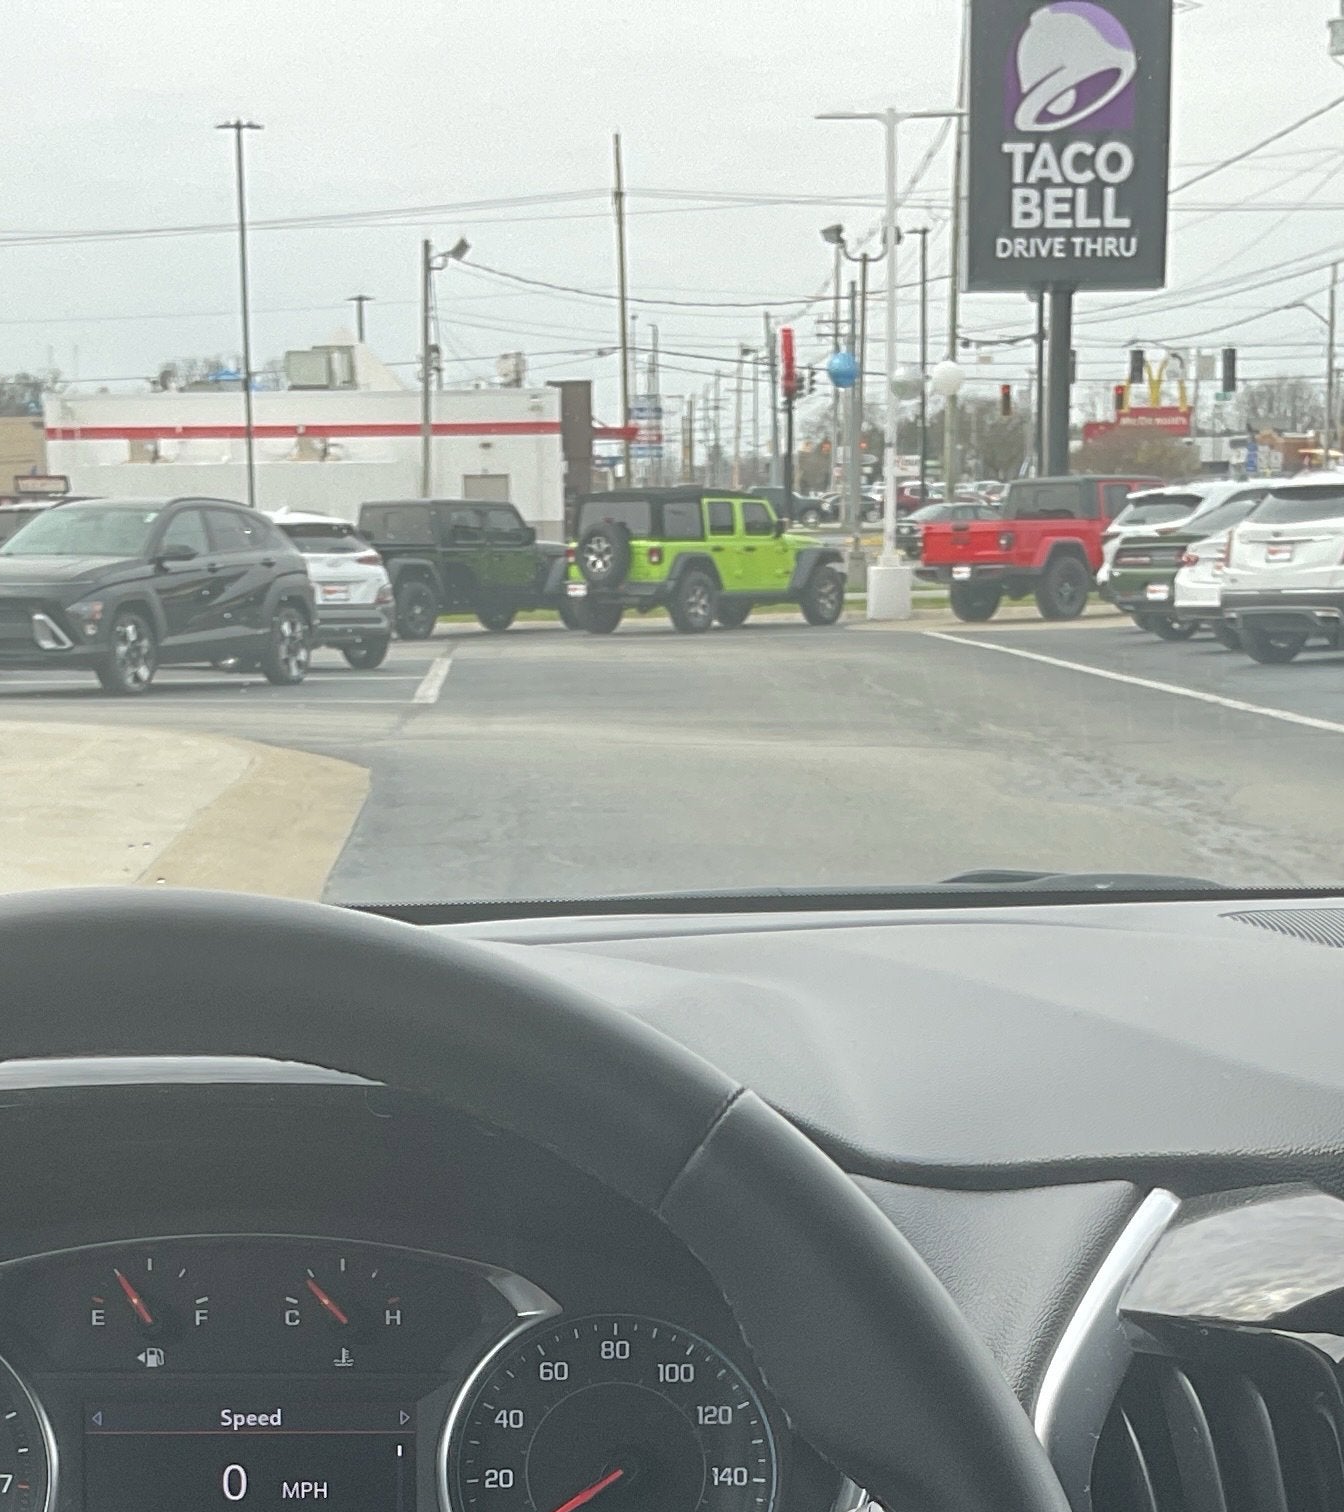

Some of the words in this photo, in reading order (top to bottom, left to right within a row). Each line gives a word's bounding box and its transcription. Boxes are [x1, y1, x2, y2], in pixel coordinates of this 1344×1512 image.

[1001, 141, 1134, 184] TACO
[1011, 187, 1131, 228] BELL
[995, 237, 1066, 258] DRIVE
[1070, 237, 1137, 258] THRU
[91, 1310, 105, 1326] E
[195, 1310, 209, 1326] F
[285, 1310, 300, 1326] C
[385, 1310, 402, 1325] H
[600, 1341, 630, 1360] 80
[539, 1361, 569, 1381] 60
[657, 1363, 694, 1383] 100
[220, 1409, 282, 1430] Speed
[494, 1409, 524, 1429] 40
[696, 1405, 733, 1425] 120
[222, 1464, 248, 1501] 0
[282, 1482, 328, 1499] MPH
[484, 1469, 514, 1488] 20
[711, 1467, 748, 1487] 140
